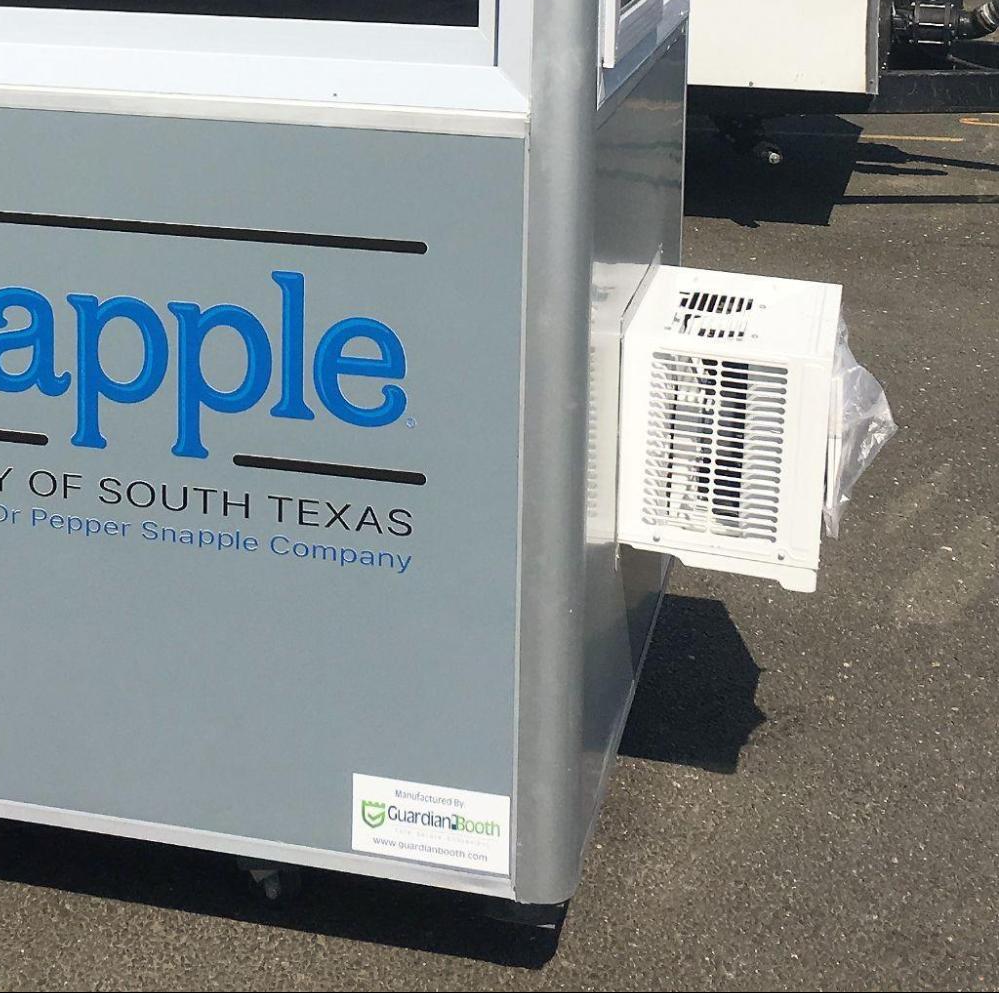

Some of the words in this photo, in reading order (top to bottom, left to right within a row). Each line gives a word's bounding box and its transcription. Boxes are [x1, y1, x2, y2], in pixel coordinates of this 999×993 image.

[28, 469, 84, 499] OF
[98, 477, 251, 519] SOUTH
[267, 495, 414, 537] TEXAS
[31, 509, 130, 538] Pepper
[141, 521, 259, 552] Snapple
[270, 534, 413, 575] Company
[395, 789, 453, 807] Manufactured
[372, 837, 488, 862] wwwguardianboothcom
